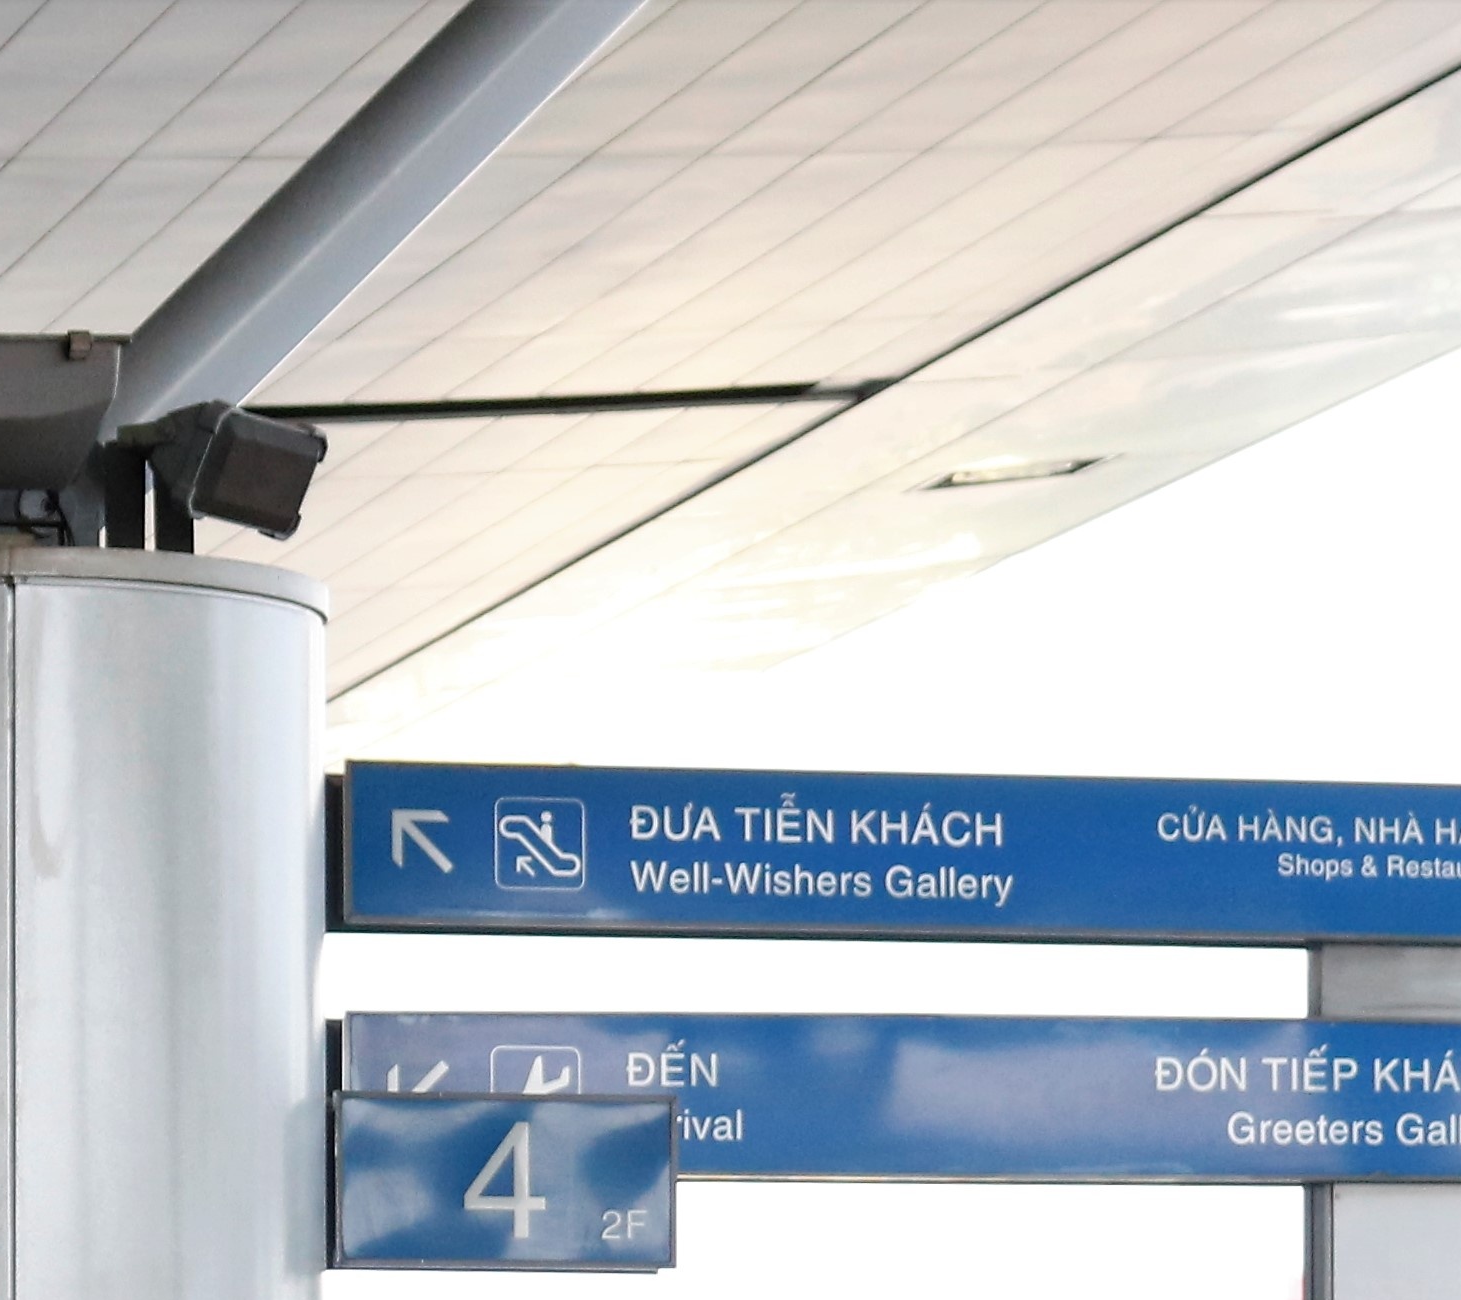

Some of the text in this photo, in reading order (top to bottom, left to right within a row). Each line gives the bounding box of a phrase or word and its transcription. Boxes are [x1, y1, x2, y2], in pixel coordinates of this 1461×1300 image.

[629, 792, 1003, 847] ĐƯA TIỄN KHÁCH
[1157, 805, 1226, 842] CỬA
[1238, 810, 1343, 847] HÀNG,
[1354, 812, 1424, 845] NHÀ
[631, 861, 1014, 907] Well-Wishers Gallery
[1278, 853, 1354, 880] Shops
[1361, 854, 1378, 877] &
[627, 1040, 718, 1088] ĐẾN
[1155, 1049, 1248, 1092] ĐÓN
[1261, 1044, 1358, 1092] TIẾP
[1227, 1111, 1383, 1146] Greeters
[464, 1122, 546, 1238] 4
[601, 1210, 648, 1240] 2F
